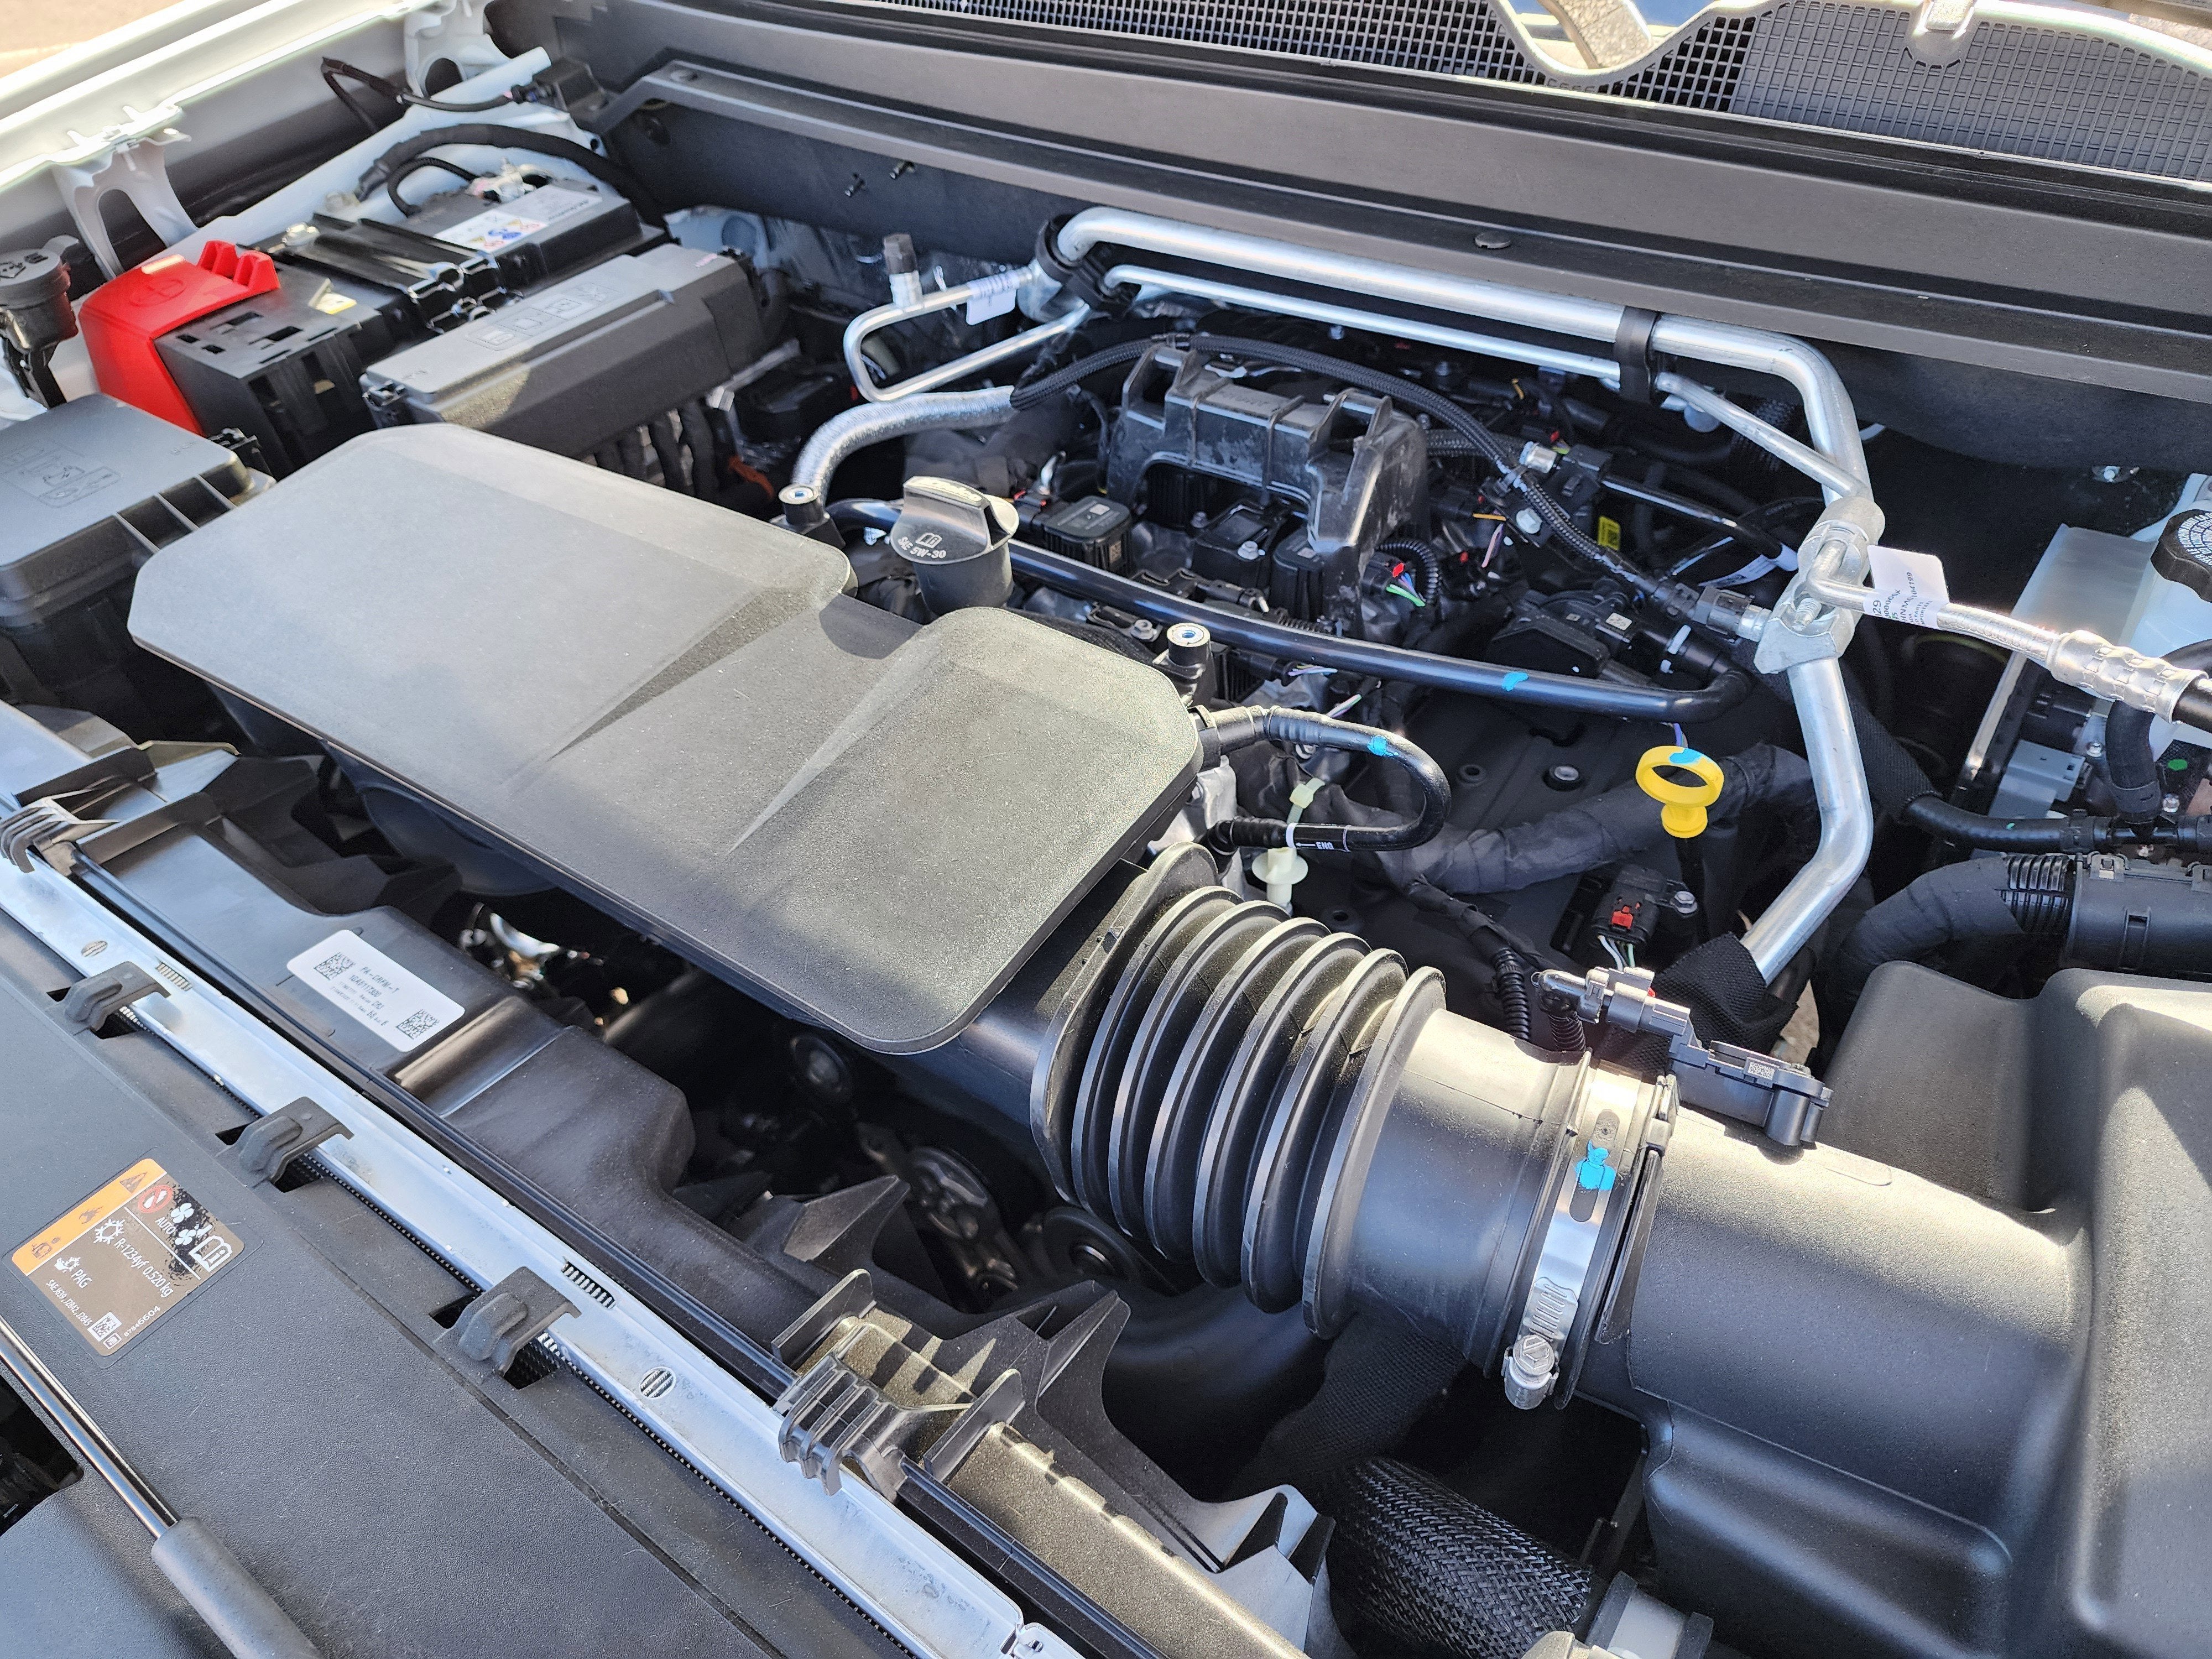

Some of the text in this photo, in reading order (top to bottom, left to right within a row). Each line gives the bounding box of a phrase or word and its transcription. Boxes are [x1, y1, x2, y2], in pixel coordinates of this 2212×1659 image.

[898, 536, 947, 559] SAE 5W-30
[155, 1217, 177, 1234] AUTO
[70, 1269, 93, 1288] PAG
[114, 1238, 174, 1298] R-1234yf 0.520 kg
